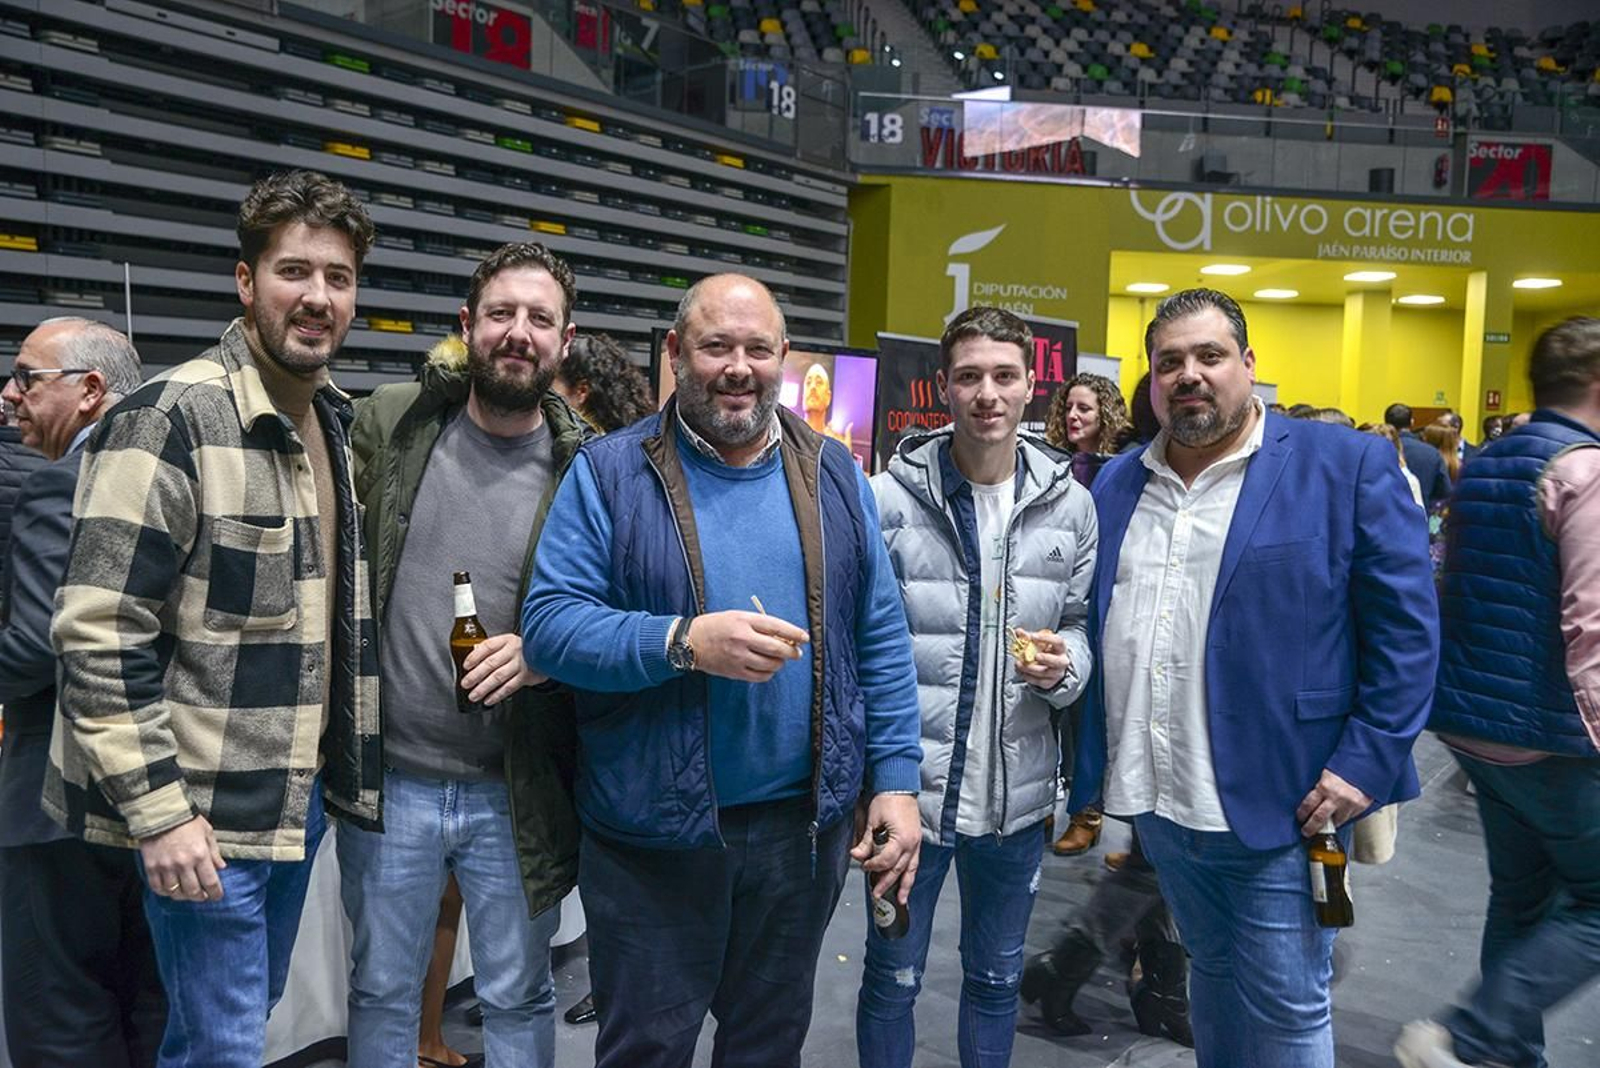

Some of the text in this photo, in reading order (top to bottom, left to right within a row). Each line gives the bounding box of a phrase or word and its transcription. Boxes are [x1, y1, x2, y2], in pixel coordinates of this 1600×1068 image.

[769, 80, 797, 119] 18
[864, 112, 903, 143] 18
[919, 107, 951, 126] Sec
[1469, 141, 1523, 159] Sector
[1224, 196, 1474, 242] olivo arena
[1317, 241, 1472, 264] JAÉN PARAÍSO INTERIOR
[973, 282, 1067, 300] DIPUTACIÓN
